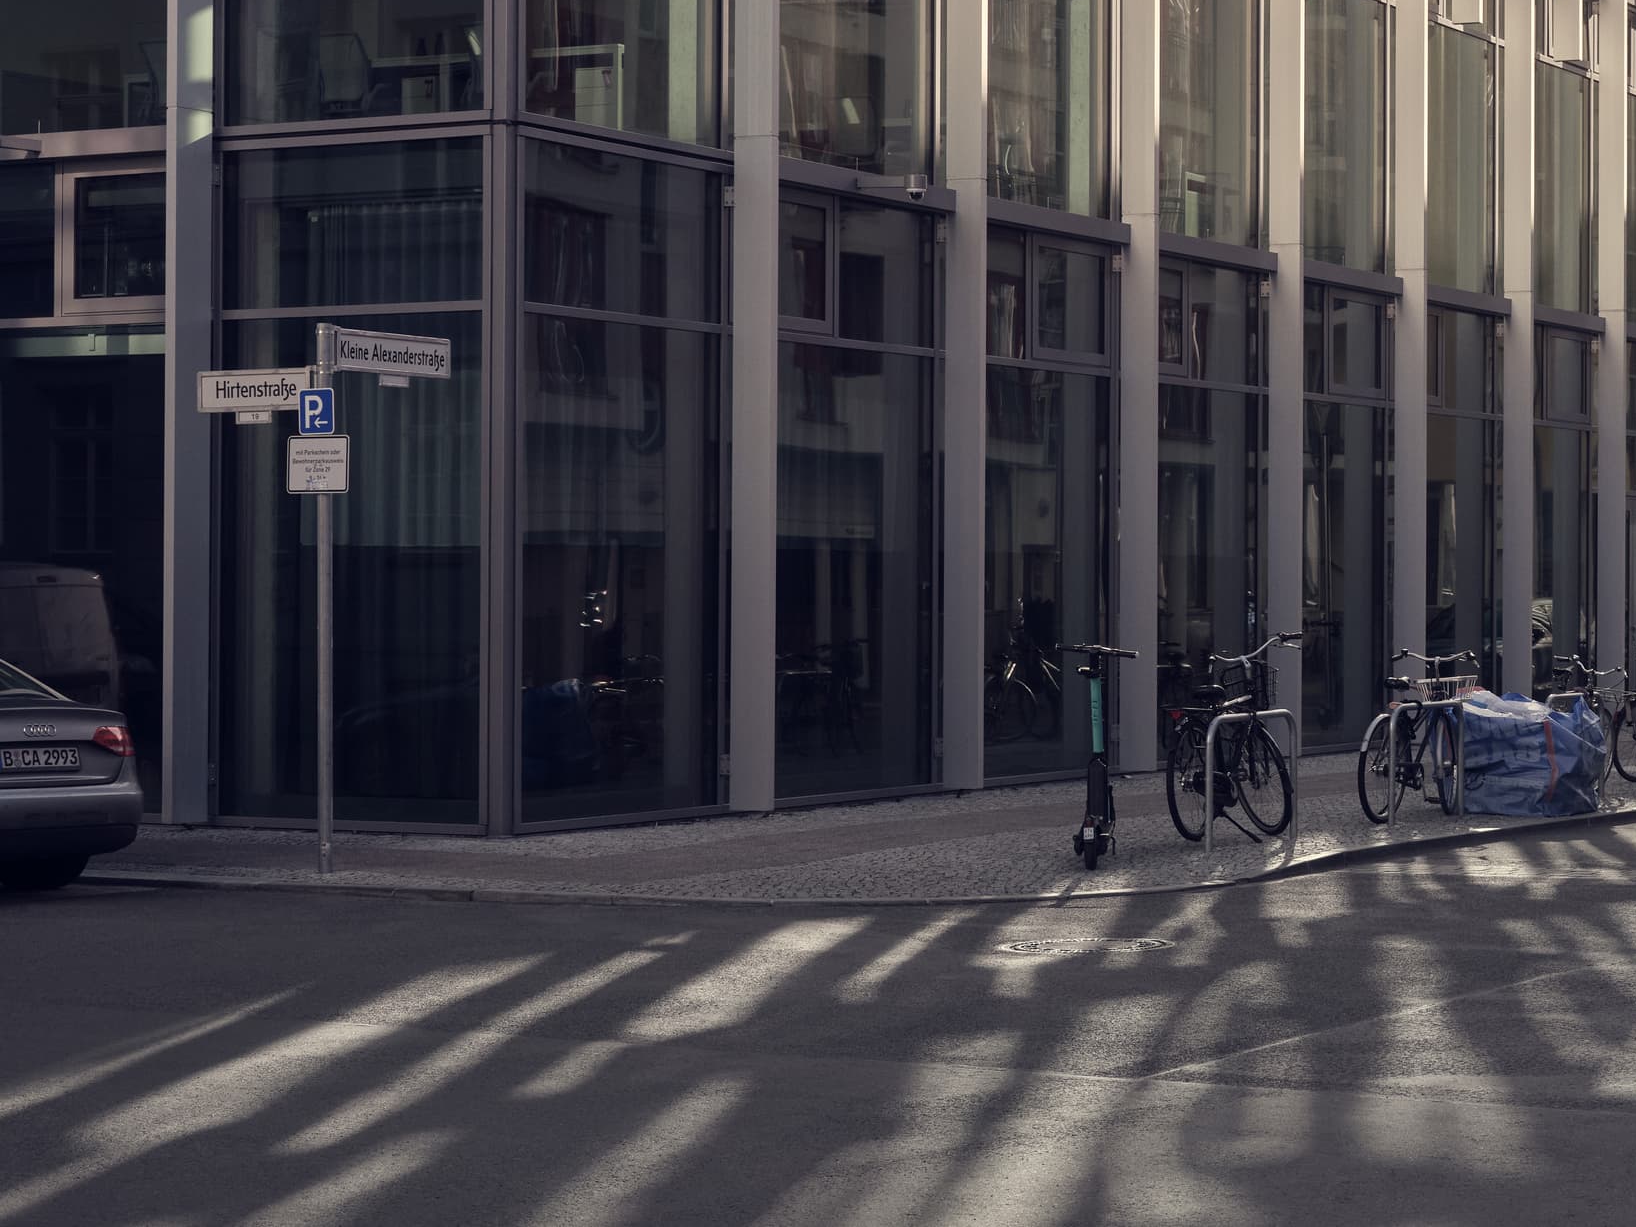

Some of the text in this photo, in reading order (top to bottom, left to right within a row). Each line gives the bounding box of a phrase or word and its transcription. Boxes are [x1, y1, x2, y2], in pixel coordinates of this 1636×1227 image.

[340, 340, 445, 371] Kleine Alexanderstraße
[215, 377, 297, 401] Hirtenstraße
[304, 394, 323, 429] P
[3, 748, 78, 767] B CA 2993
